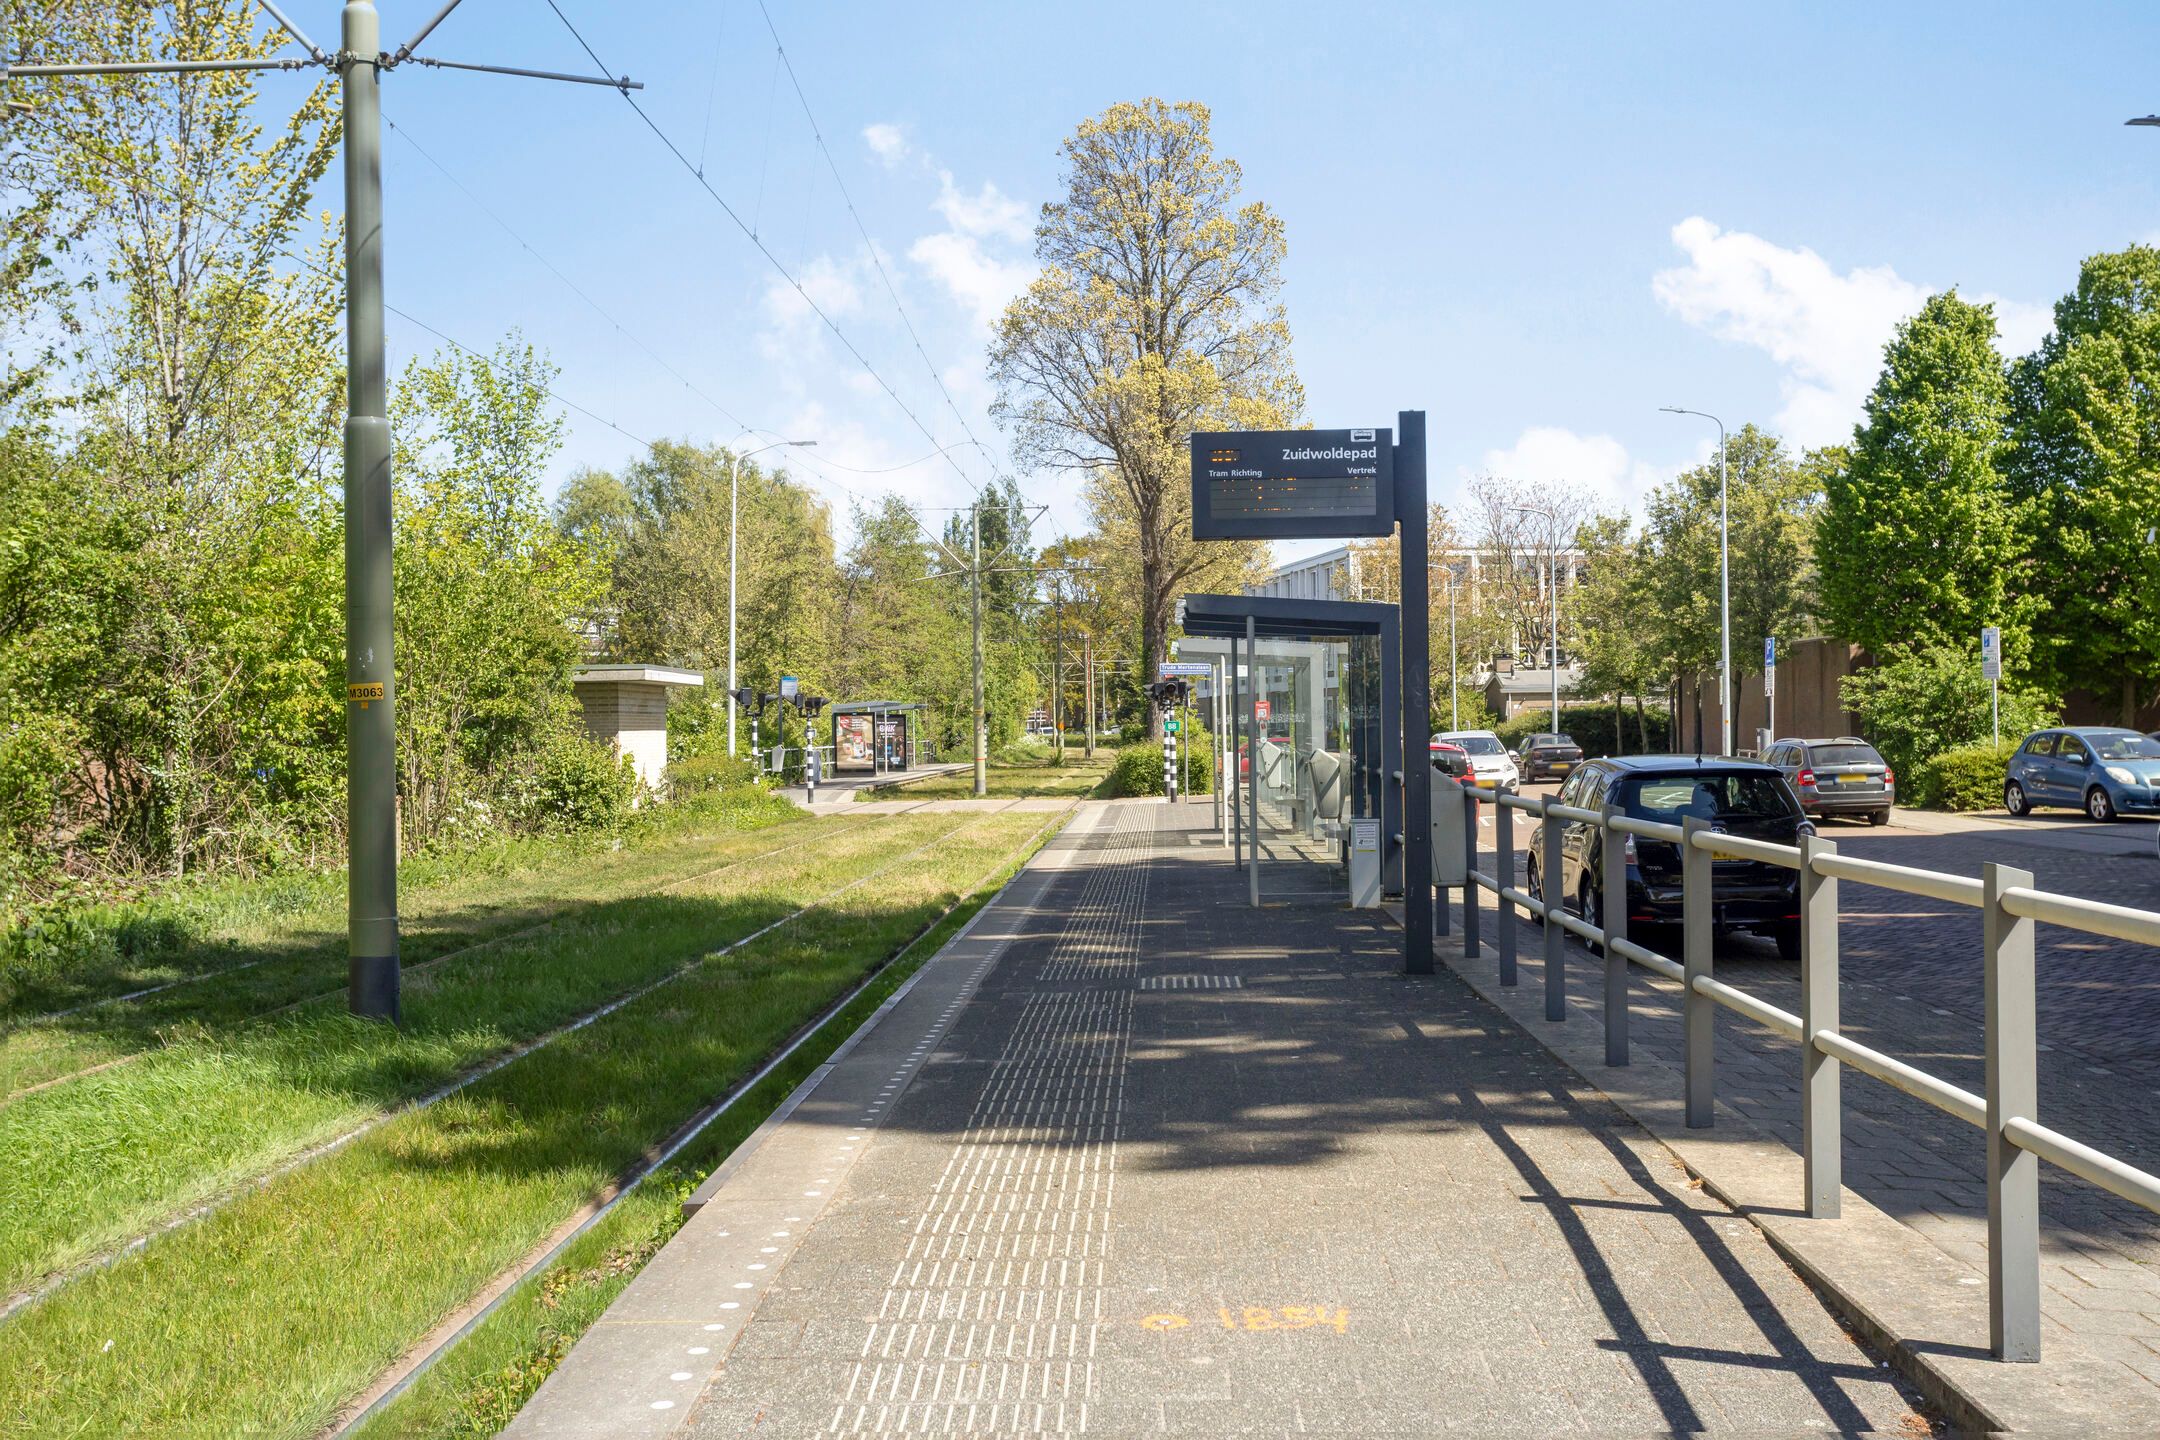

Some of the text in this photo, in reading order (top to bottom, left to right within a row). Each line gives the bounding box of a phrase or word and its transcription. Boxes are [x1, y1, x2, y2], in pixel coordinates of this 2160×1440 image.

[1282, 446, 1377, 461] Zuidwoldepad
[1208, 468, 1263, 478] Tram Richting
[1346, 466, 1377, 474] Vertrek
[349, 687, 383, 699] M3063
